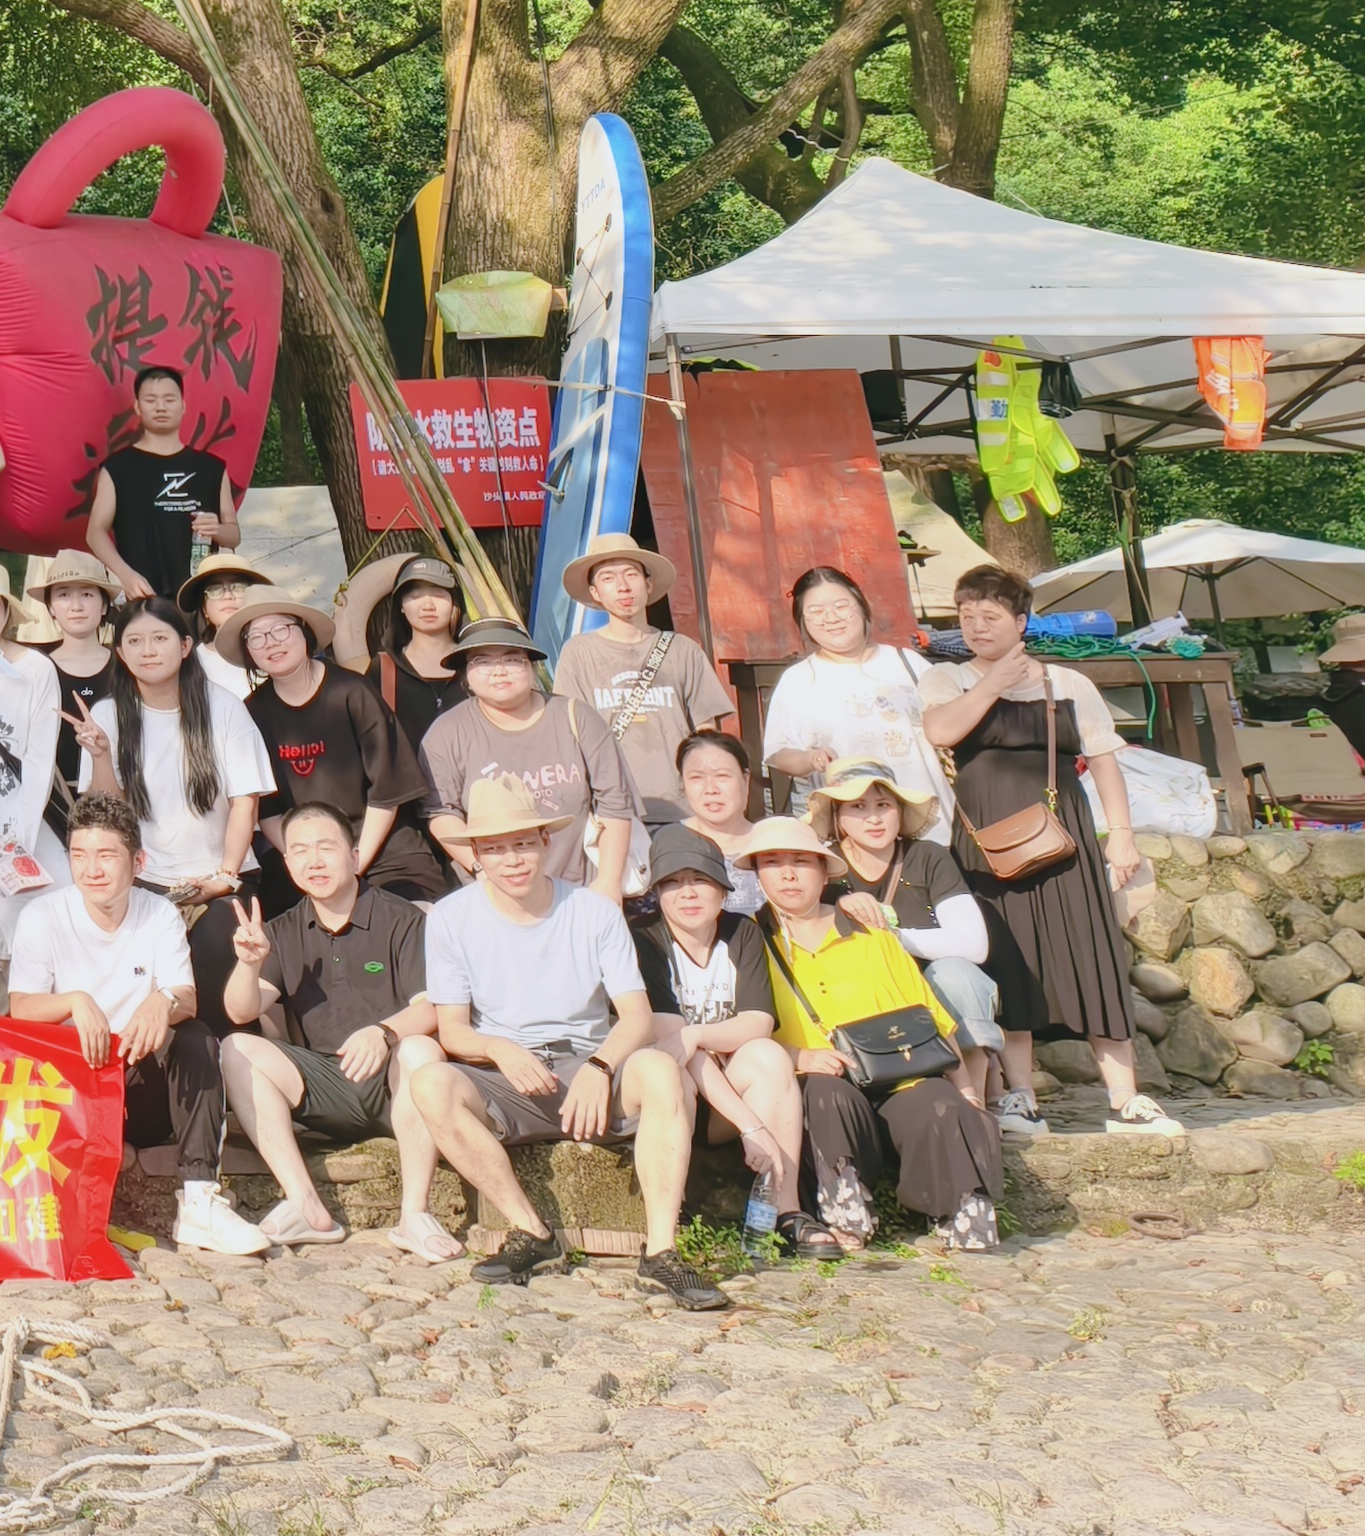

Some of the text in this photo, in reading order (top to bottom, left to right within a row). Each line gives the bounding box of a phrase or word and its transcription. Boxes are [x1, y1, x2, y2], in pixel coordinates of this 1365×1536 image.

[366, 406, 541, 452] 防水救生物资点
